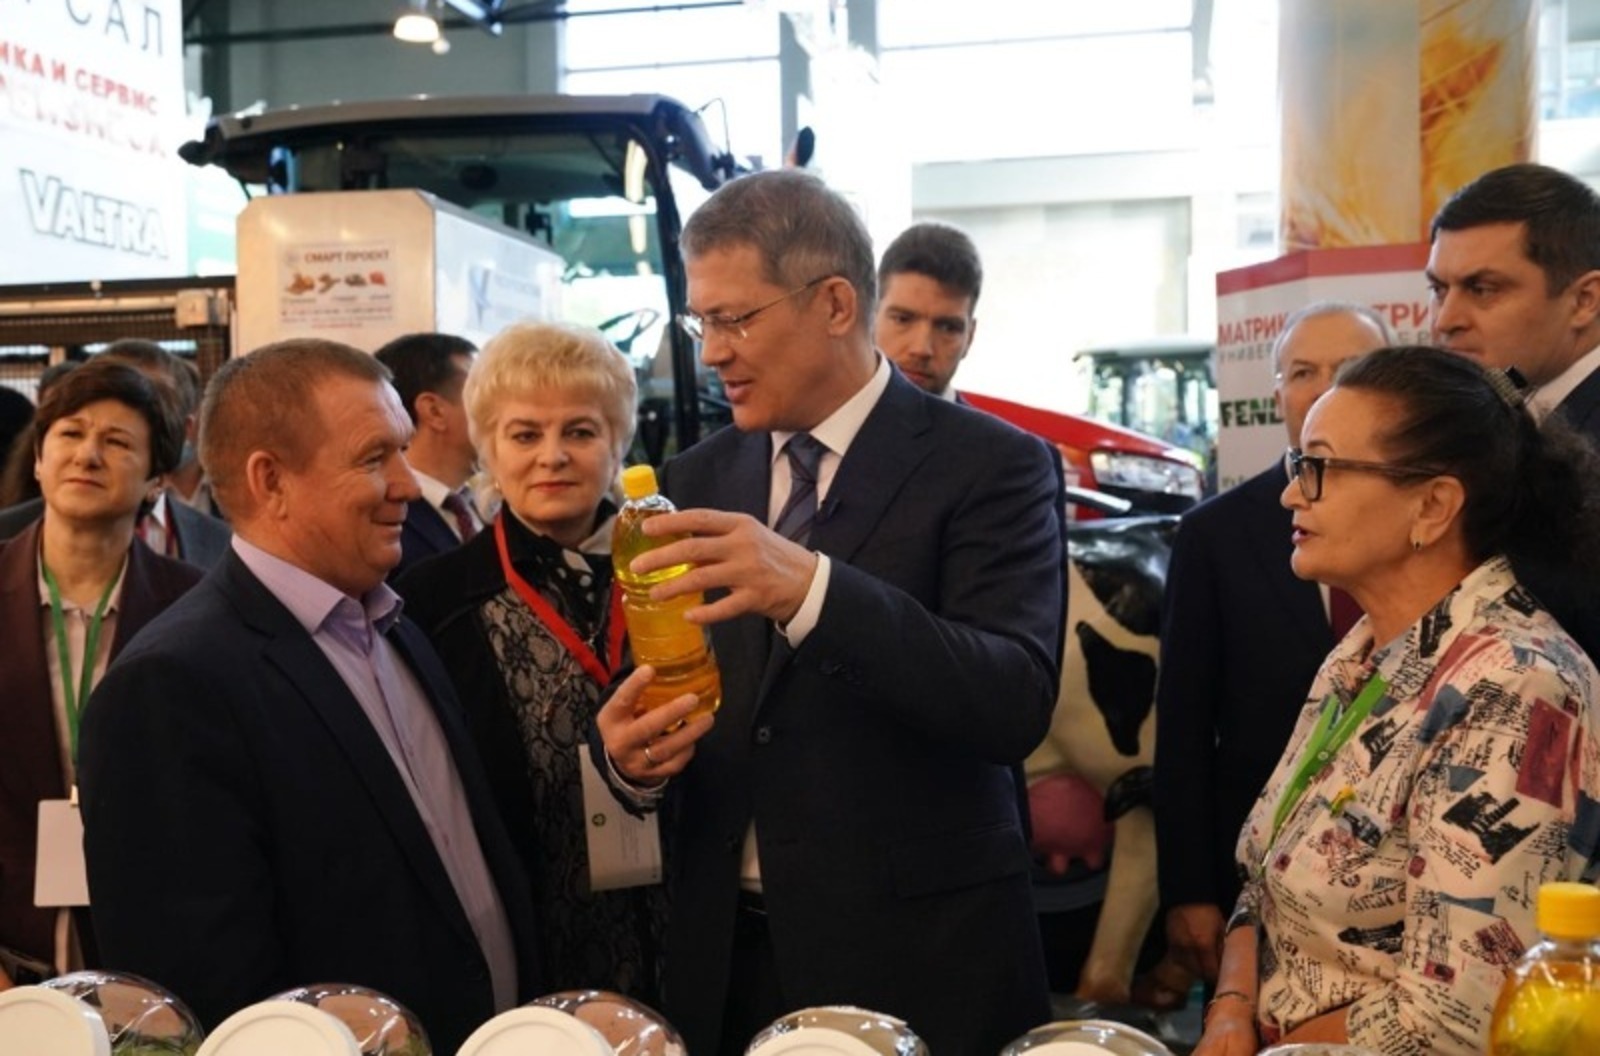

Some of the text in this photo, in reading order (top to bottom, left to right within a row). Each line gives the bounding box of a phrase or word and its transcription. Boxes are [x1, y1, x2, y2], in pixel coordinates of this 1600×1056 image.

[25, 0, 163, 57] САЛ
[52, 58, 66, 84] И
[75, 68, 158, 115] СЕРВИС
[18, 167, 169, 261] VALTRA
[304, 248, 390, 264] СМАРТ ПРОЕКТ
